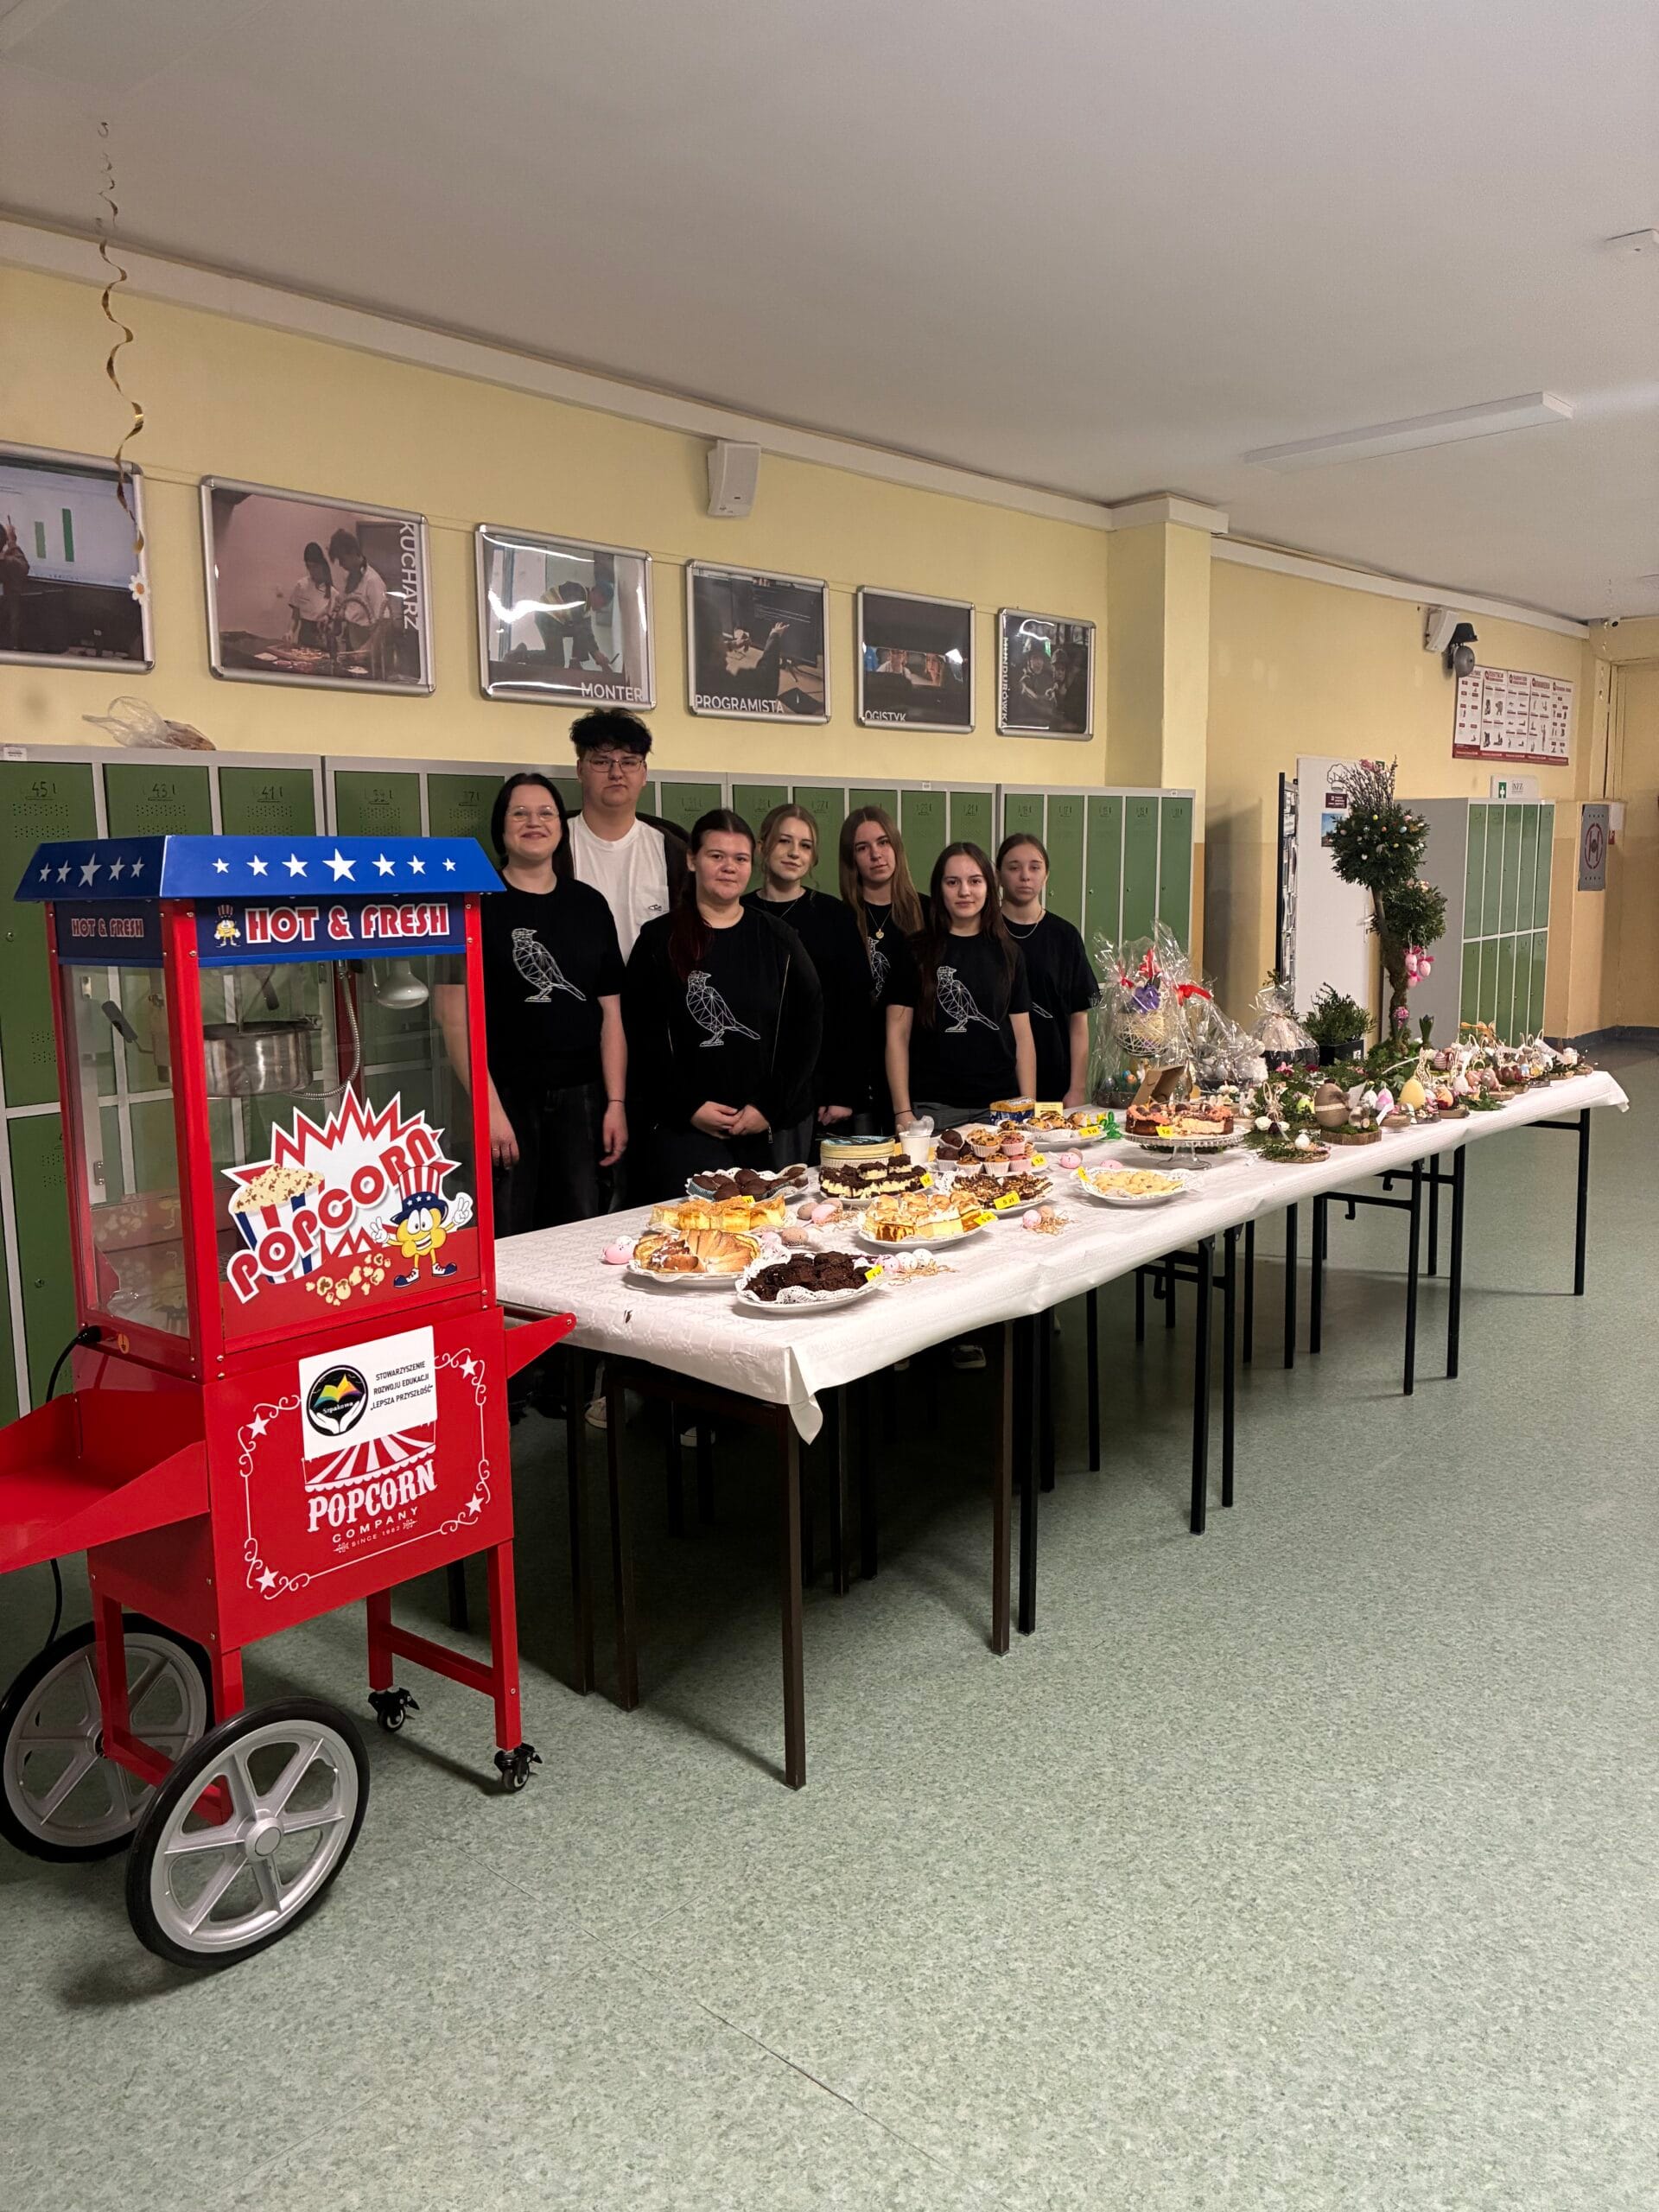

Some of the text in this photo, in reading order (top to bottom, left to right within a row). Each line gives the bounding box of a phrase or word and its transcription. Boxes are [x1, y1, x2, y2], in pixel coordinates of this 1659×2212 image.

[399, 520, 419, 631] KUCHARZ
[581, 682, 642, 702] MONTER
[695, 694, 785, 714] PROGRAMISTA
[71, 918, 145, 938] HOT & FRESH
[245, 903, 450, 944] HOT & FRESH
[228, 1124, 440, 1302] POPCORN
[375, 1360, 426, 1382] STOWARZYSZENIE
[373, 1373, 429, 1395] ROZWOJU EDUKACJI
[307, 1459, 438, 1533] POPCORN
[332, 1506, 418, 1543] COMPANY
[351, 1534, 378, 1548] SINCE
